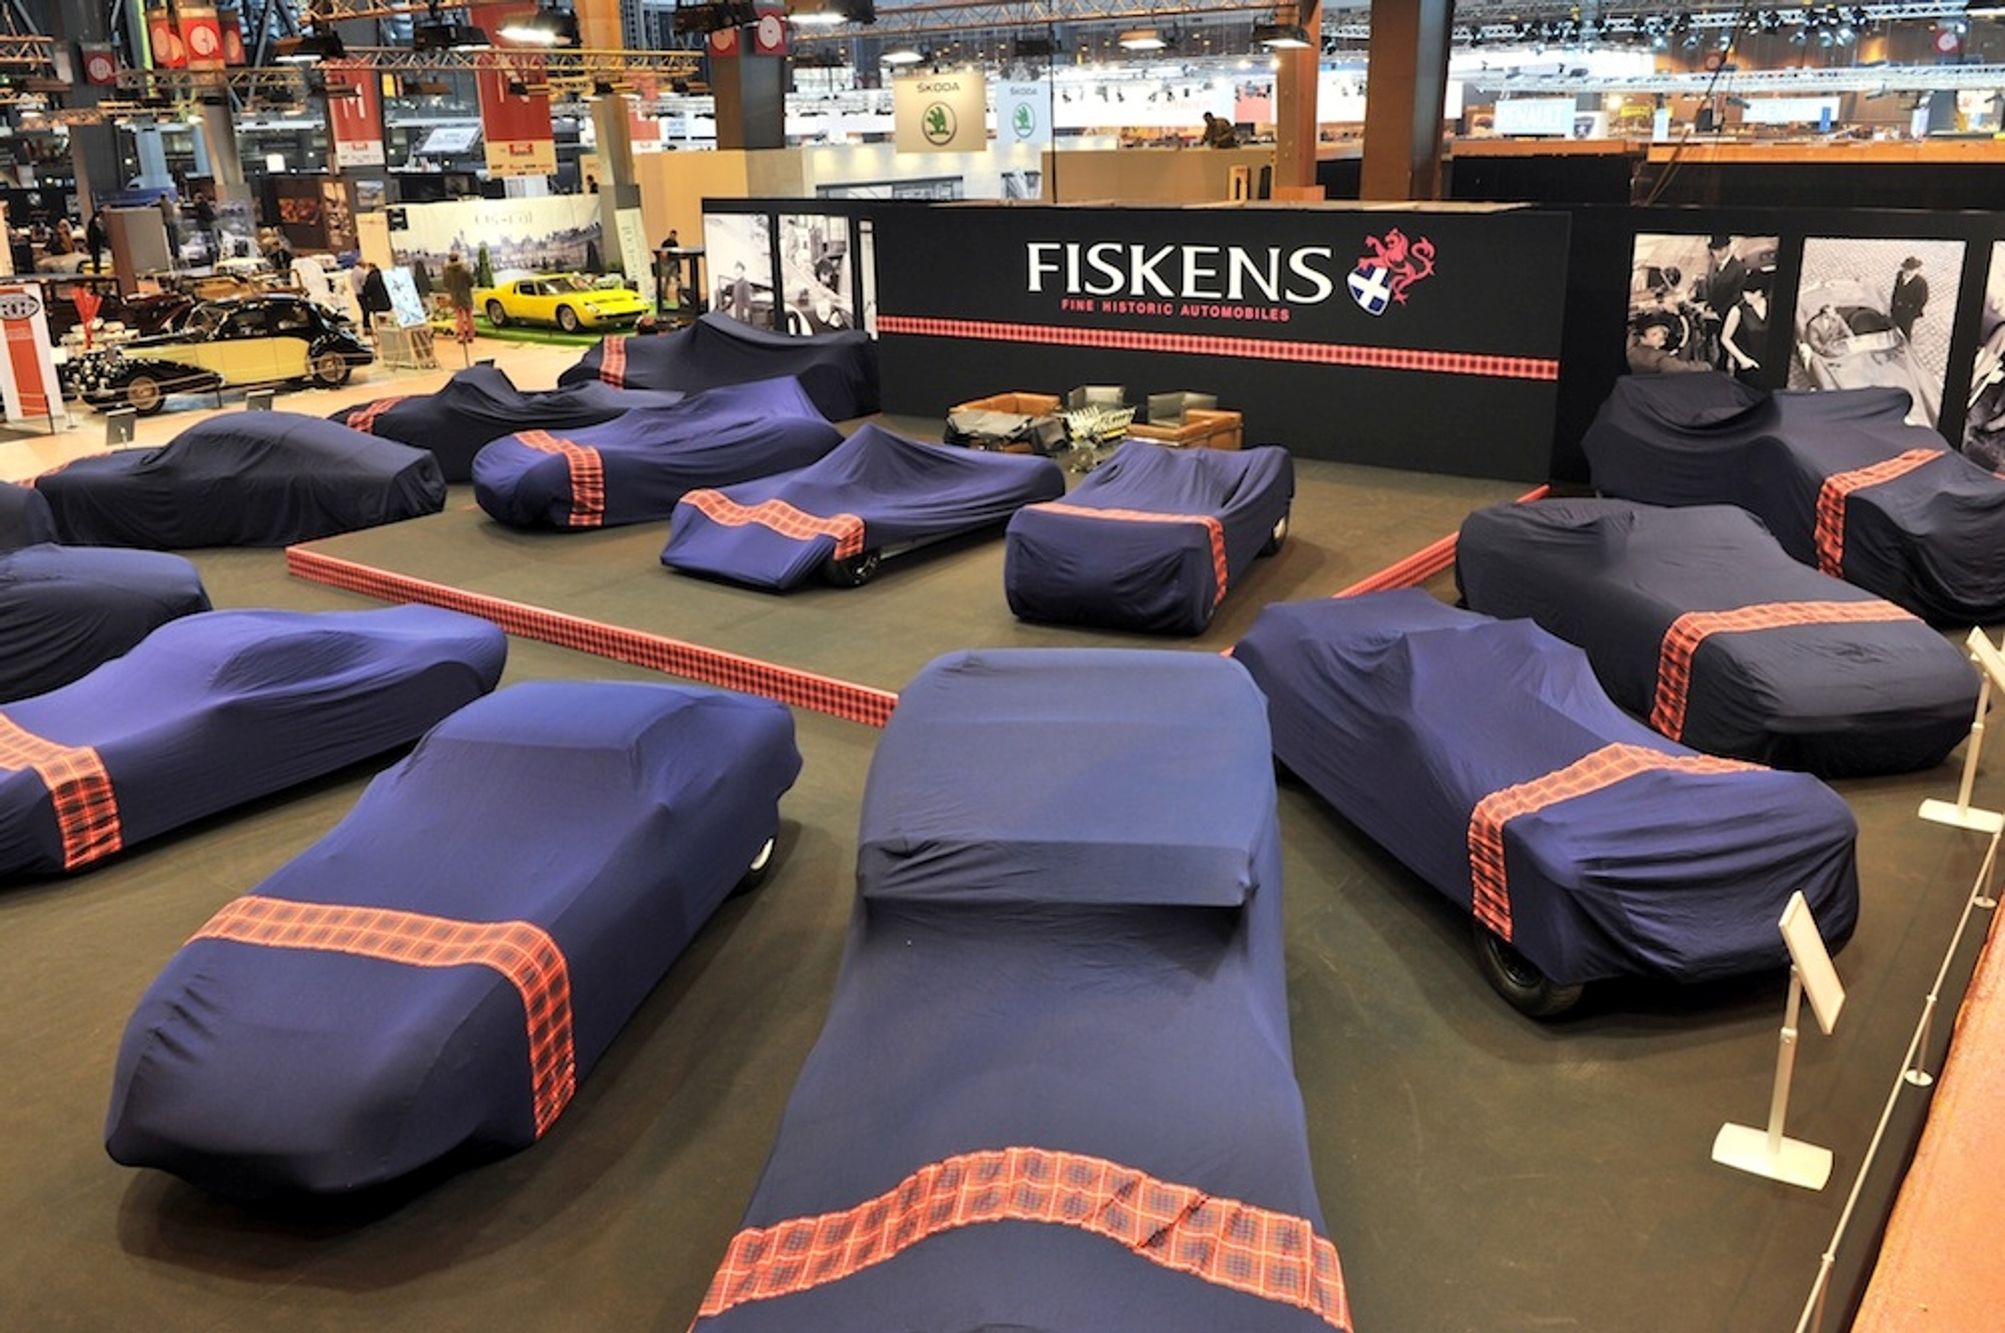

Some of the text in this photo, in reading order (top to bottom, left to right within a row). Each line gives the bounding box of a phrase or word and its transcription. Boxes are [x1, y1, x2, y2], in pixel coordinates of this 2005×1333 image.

[1027, 243, 1334, 304] FISKENS
[1061, 299, 1290, 321] FINE HISTORIC AUTOMOBILES
